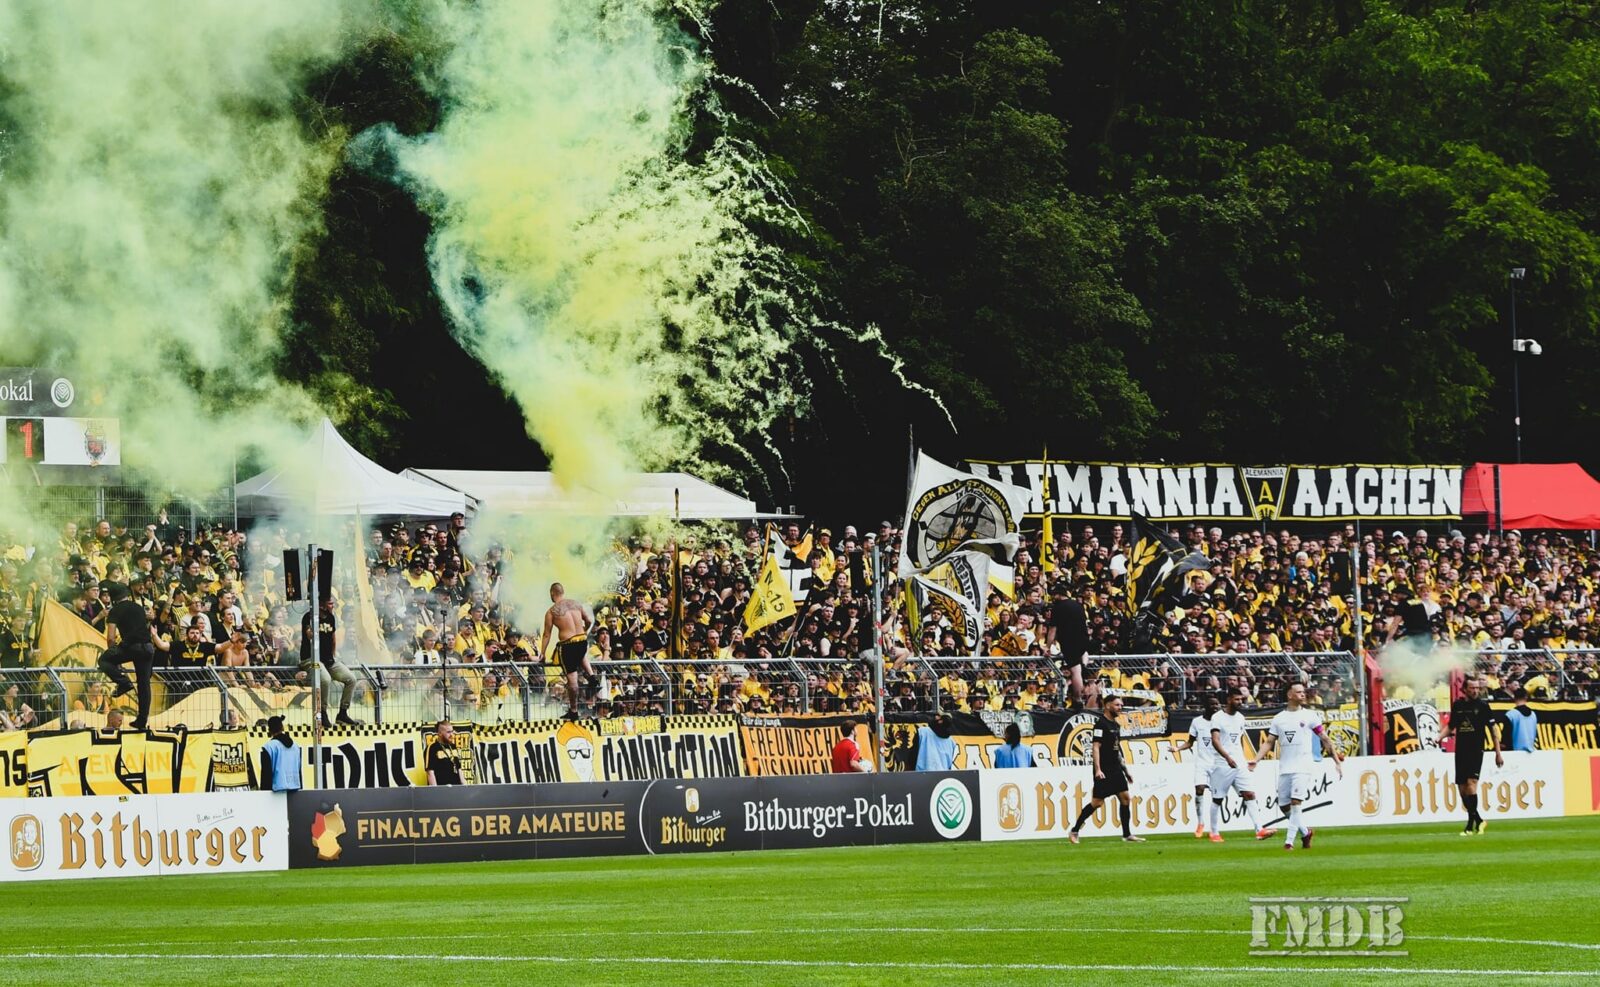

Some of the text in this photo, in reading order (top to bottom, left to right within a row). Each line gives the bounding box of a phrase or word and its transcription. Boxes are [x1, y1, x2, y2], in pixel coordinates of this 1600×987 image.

[20, 421, 33, 458] 1
[1259, 480, 1275, 502] A
[1292, 467, 1462, 517] AACHEN
[357, 811, 626, 840] FINALTAG DER AMATEURE
[661, 816, 726, 847] Bitburger
[744, 793, 914, 838] Bitburger-Pokal
[59, 811, 267, 870] Bitburger
